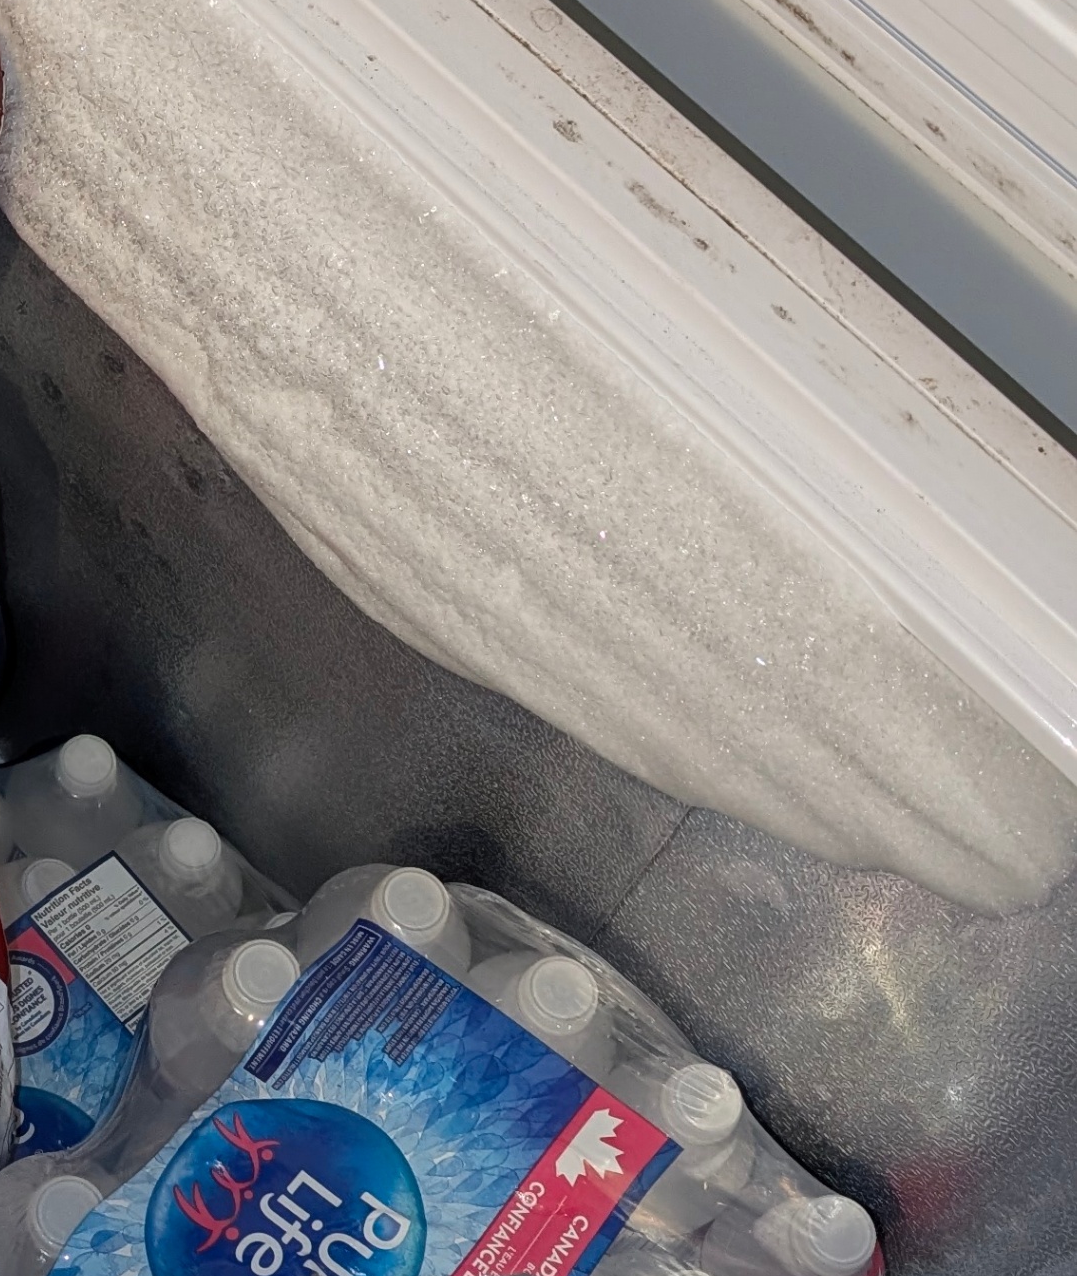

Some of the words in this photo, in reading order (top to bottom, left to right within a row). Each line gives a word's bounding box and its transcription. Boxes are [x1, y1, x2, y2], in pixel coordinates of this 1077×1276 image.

[33, 891, 70, 922] Nutrition
[68, 876, 92, 895] Facts
[40, 906, 68, 929] Valeur
[66, 883, 101, 910] nutritive
[235, 1170, 343, 1276] Life
